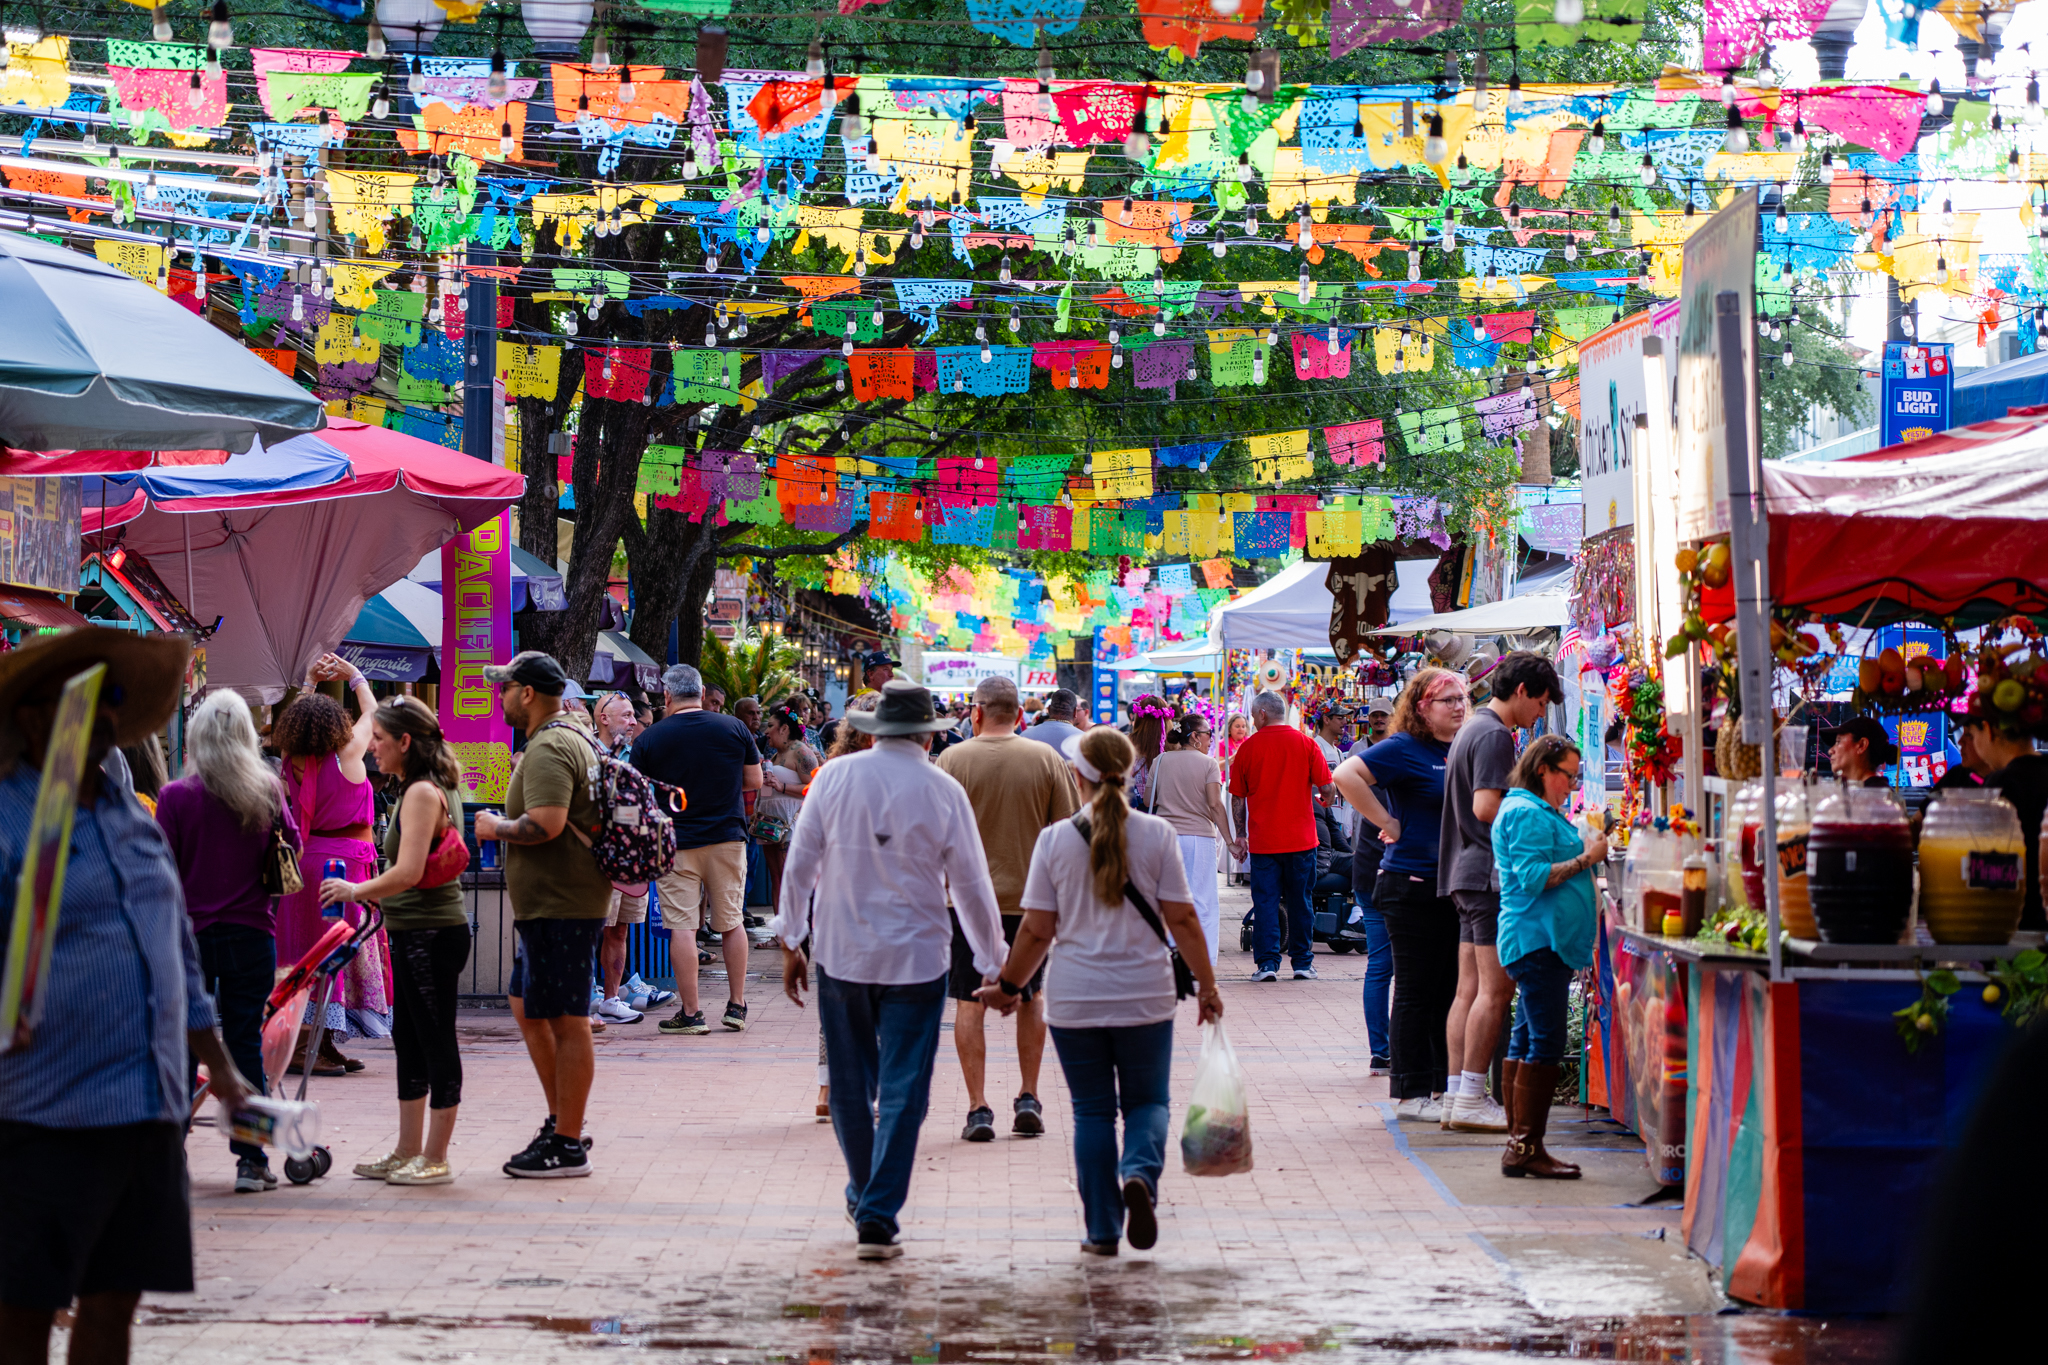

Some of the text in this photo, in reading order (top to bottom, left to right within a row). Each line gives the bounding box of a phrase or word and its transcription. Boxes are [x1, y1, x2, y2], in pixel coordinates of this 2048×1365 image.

[1897, 401, 1938, 414] LIGHT
[1902, 390, 1933, 402] BUD
[453, 516, 502, 720] PACIFICO
[341, 644, 413, 679] Margarita
